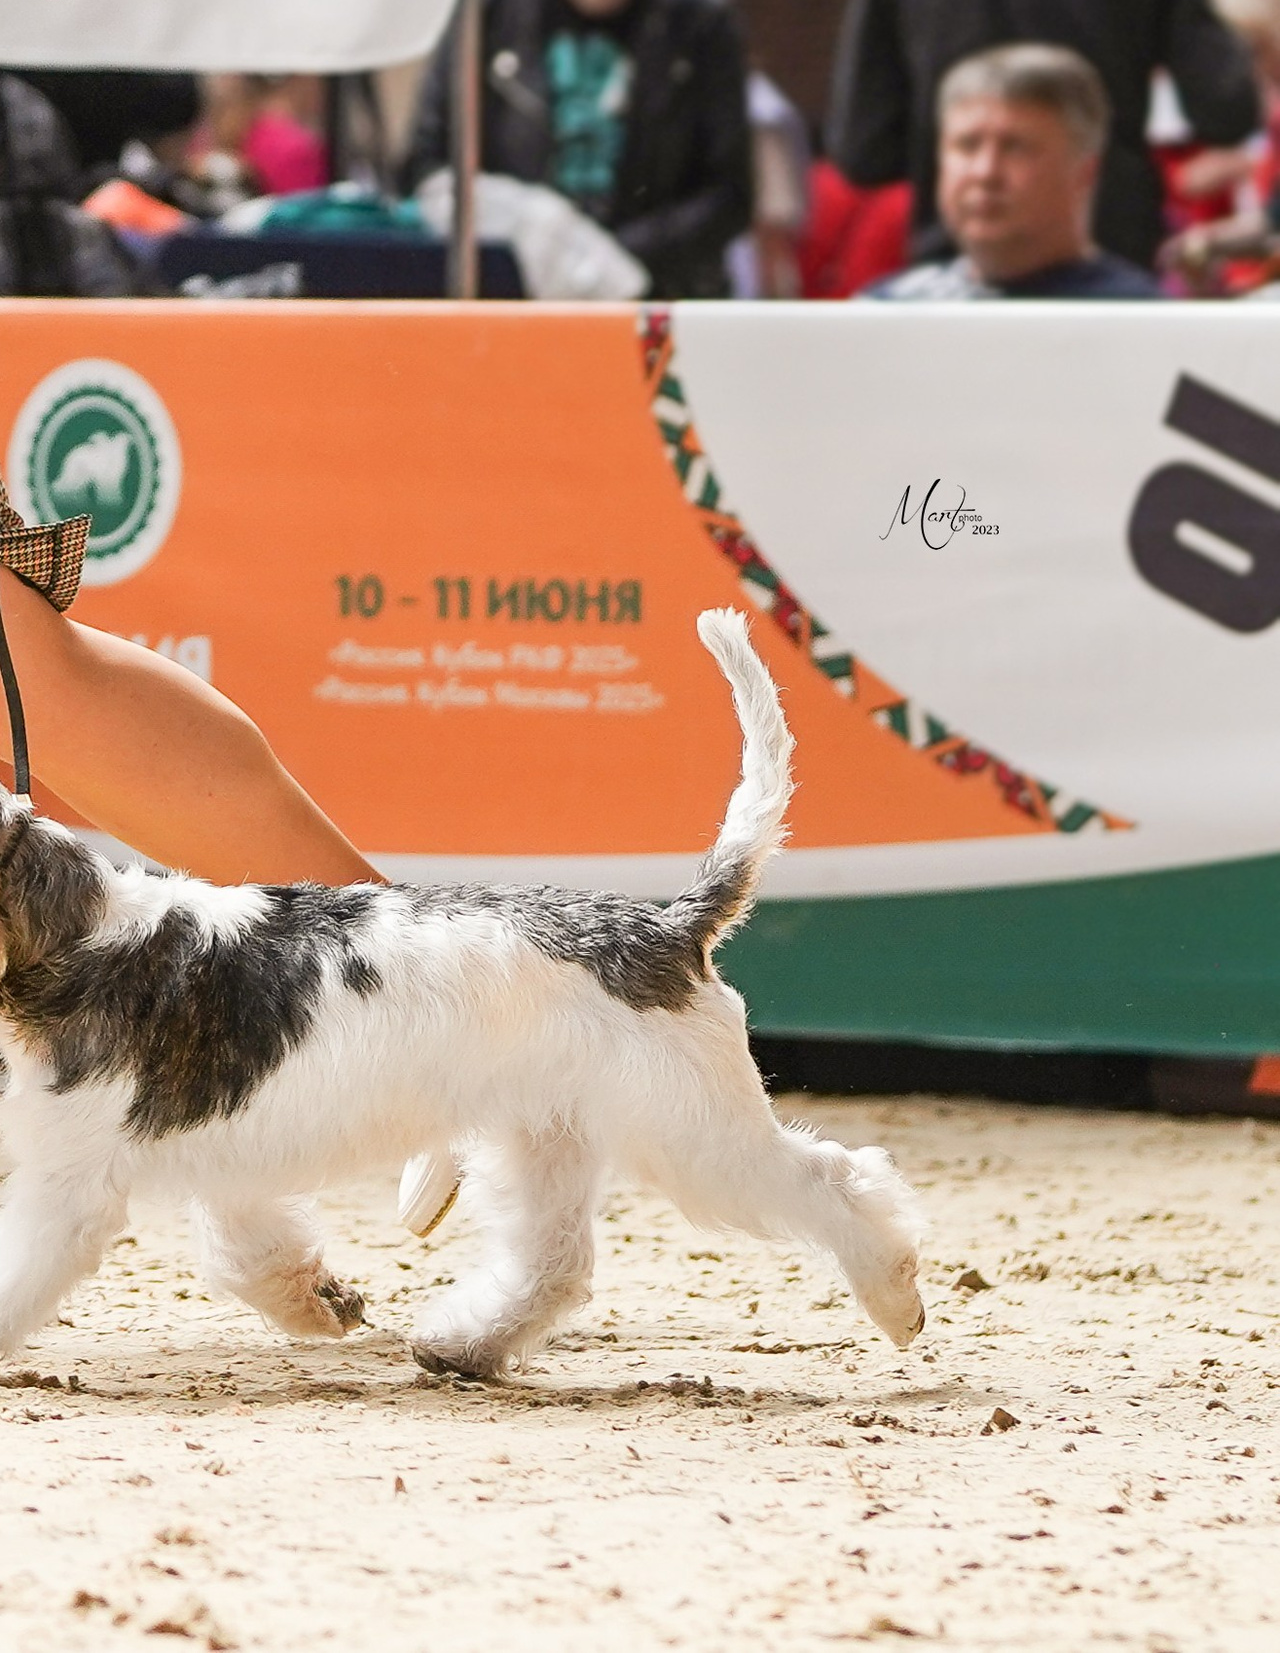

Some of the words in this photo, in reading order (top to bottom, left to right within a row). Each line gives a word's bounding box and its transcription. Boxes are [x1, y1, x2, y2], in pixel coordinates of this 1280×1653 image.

[335, 573, 385, 619] 10
[434, 575, 472, 620] 11
[486, 577, 642, 623] ИЮНЯ
